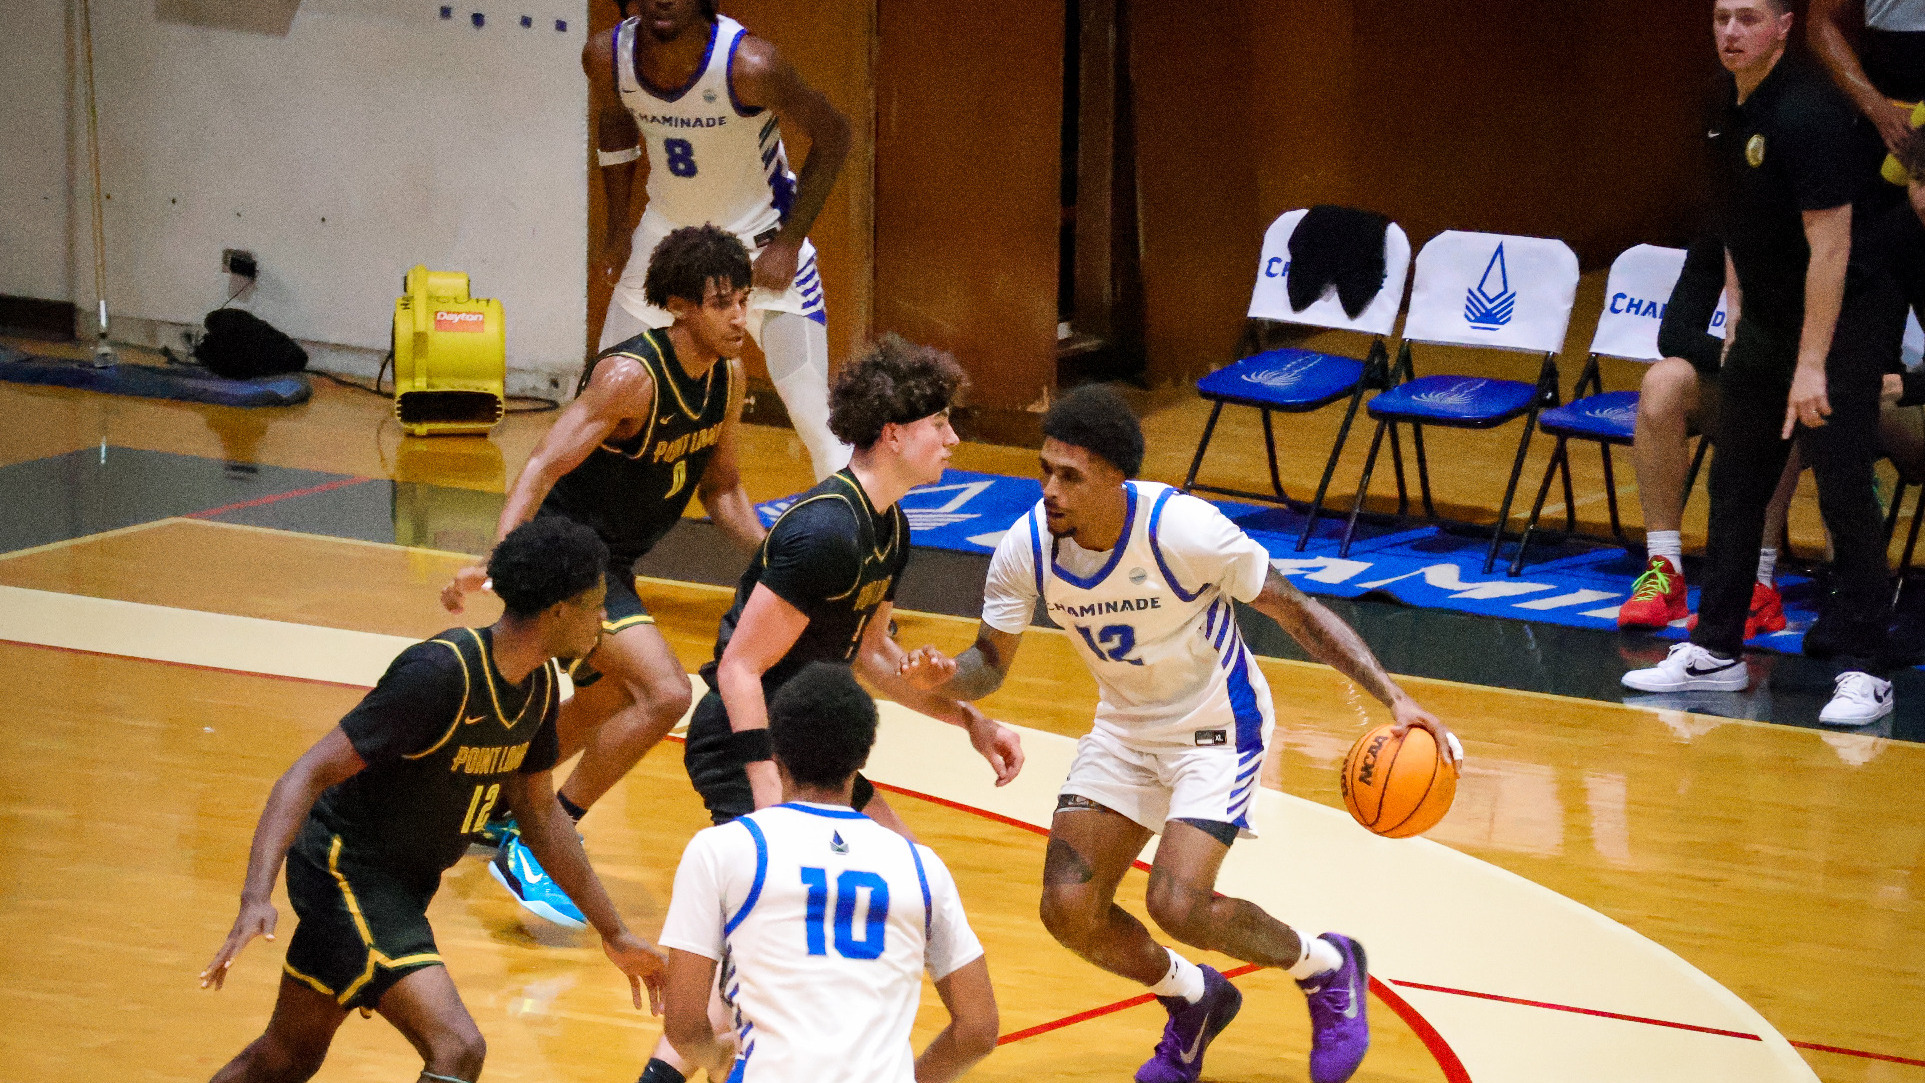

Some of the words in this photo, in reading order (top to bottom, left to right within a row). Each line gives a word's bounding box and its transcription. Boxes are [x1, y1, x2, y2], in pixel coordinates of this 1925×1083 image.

[631, 108, 728, 129] HAMINADE
[664, 137, 698, 178] 8
[436, 311, 484, 324] Dayton
[664, 460, 687, 499] 0
[1075, 624, 1144, 666] 12
[450, 745, 502, 774] POINT
[1359, 735, 1389, 787] NCAA
[460, 783, 501, 834] 12
[800, 866, 890, 960] 10
